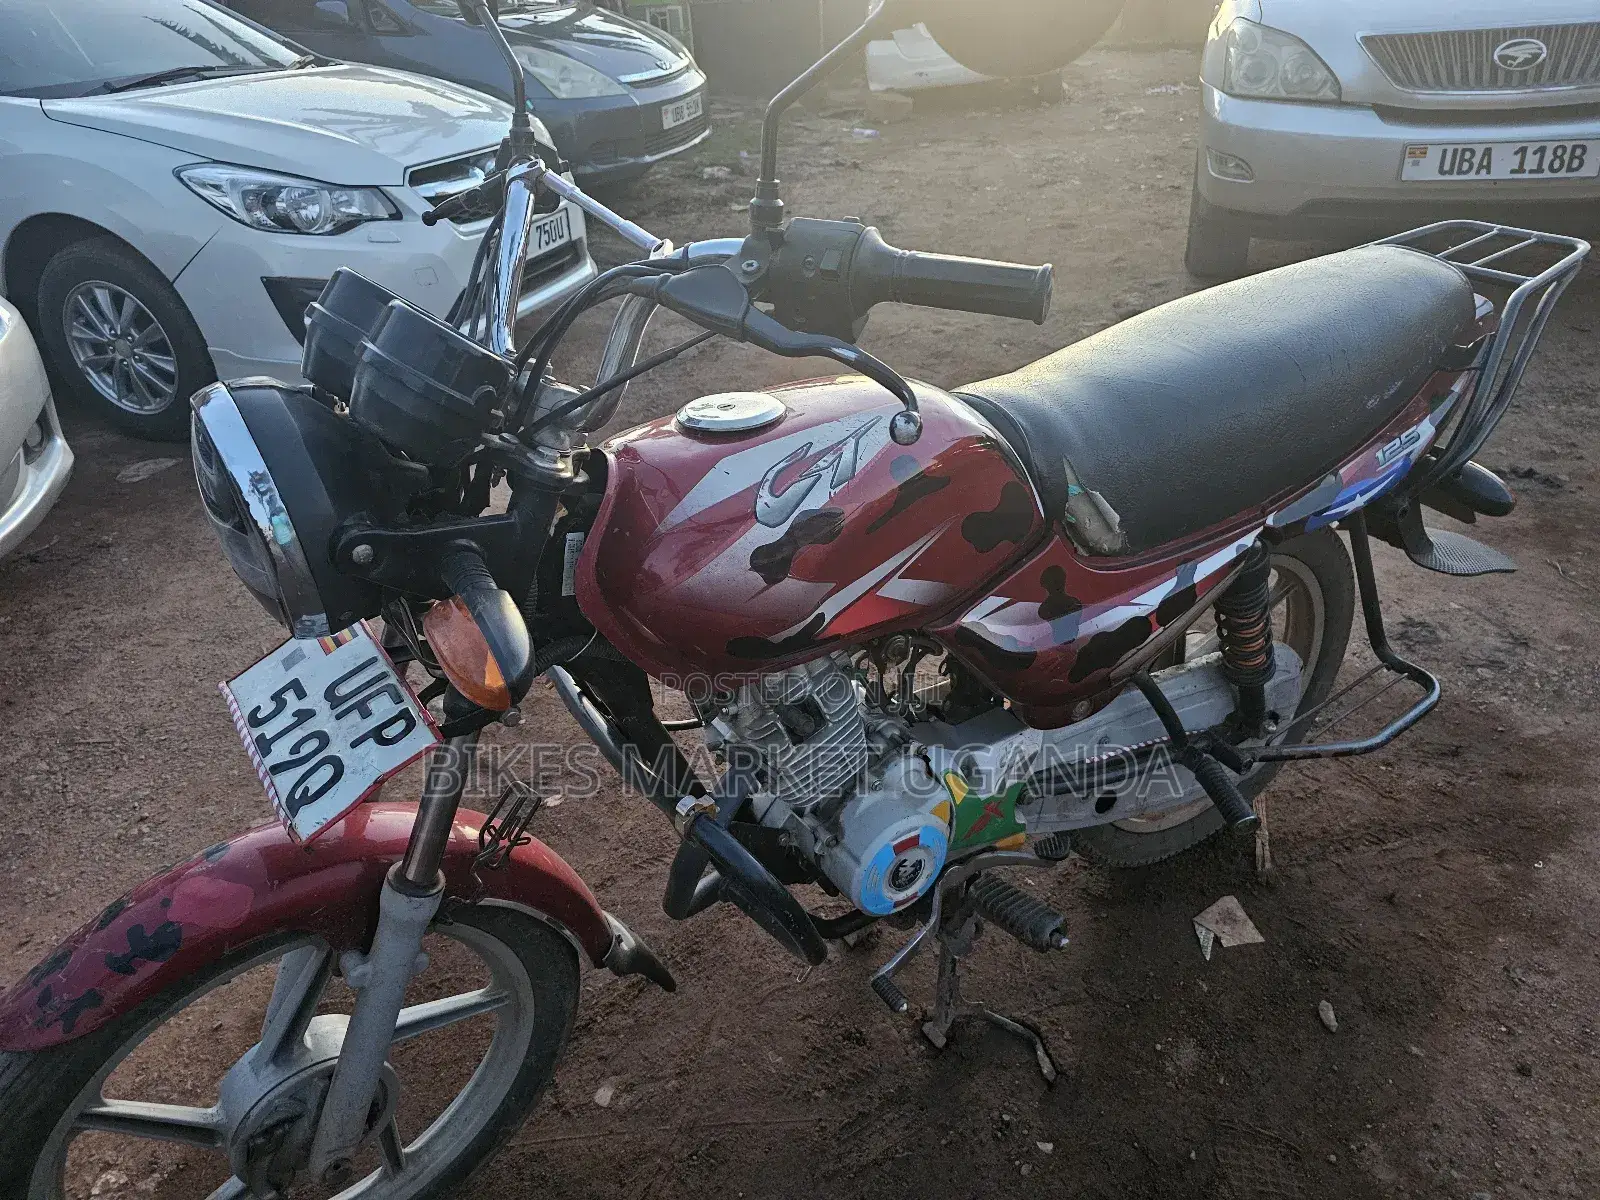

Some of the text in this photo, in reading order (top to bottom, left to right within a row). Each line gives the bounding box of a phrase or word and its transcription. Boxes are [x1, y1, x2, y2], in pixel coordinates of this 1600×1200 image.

[1437, 143, 1588, 176] UBA 118B
[535, 215, 565, 250] 750U
[1375, 424, 1421, 467] 125
[323, 655, 417, 750] UFP
[247, 677, 345, 819] 519Q
